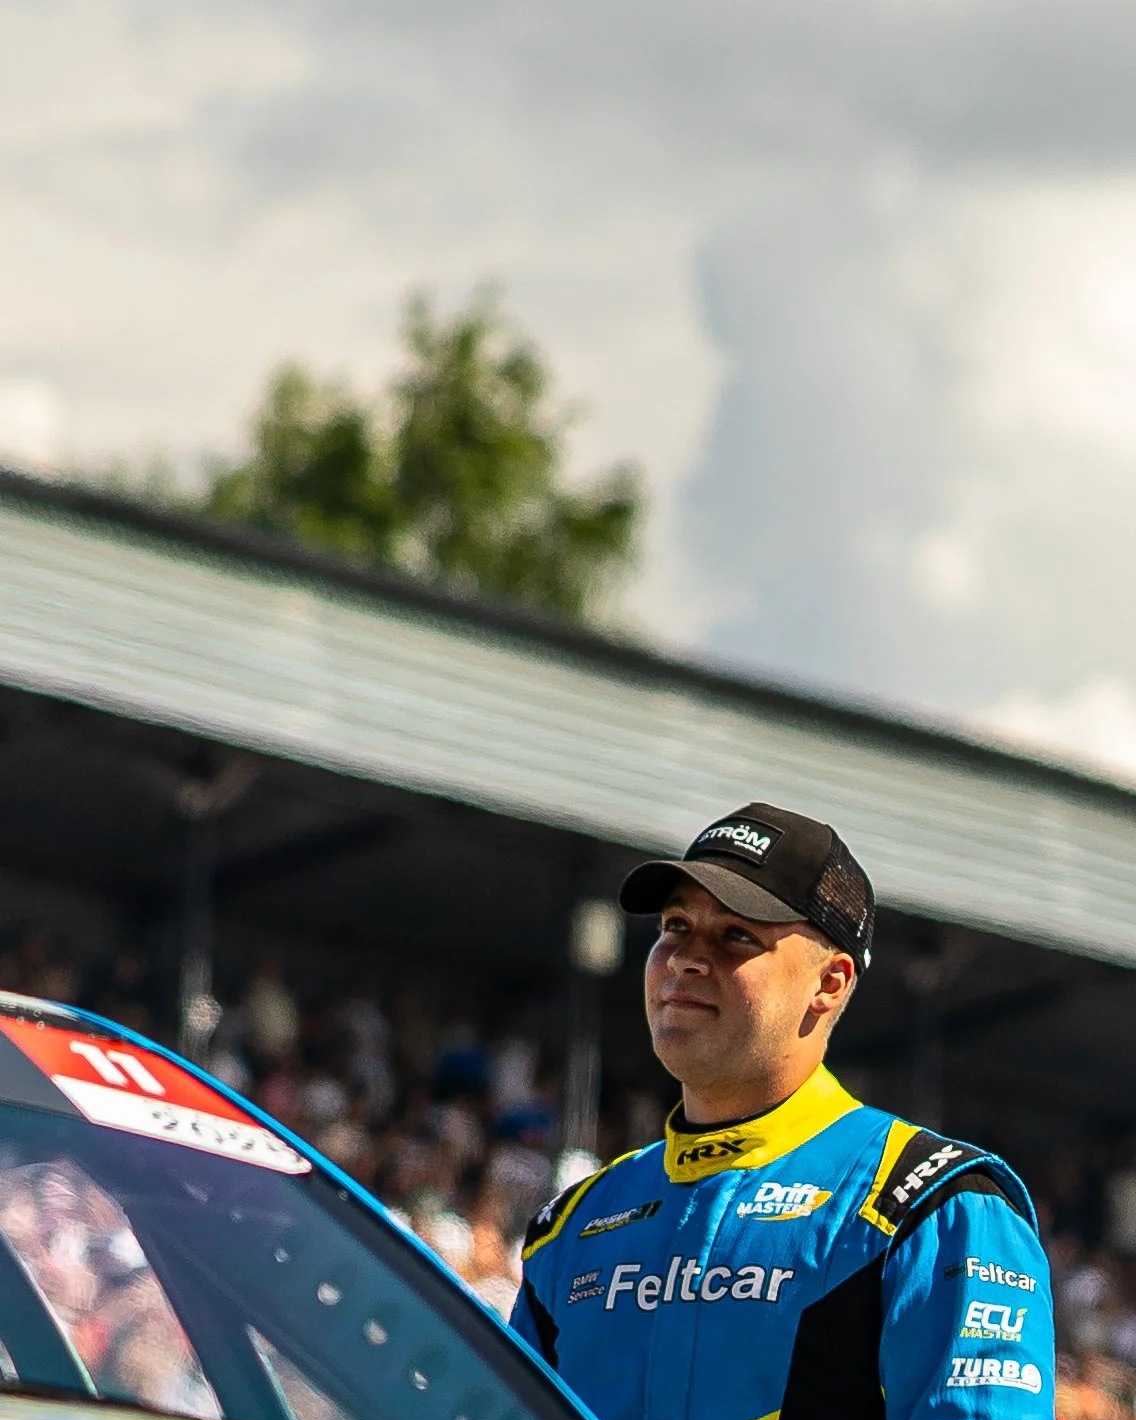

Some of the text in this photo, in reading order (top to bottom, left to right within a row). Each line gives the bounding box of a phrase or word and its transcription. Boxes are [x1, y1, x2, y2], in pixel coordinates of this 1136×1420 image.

[69, 1040, 165, 1096] 11
[676, 1137, 748, 1166] HRX
[892, 1143, 963, 1204] HRX
[754, 1182, 820, 1205] Drift
[737, 1201, 813, 1219] MASTERS
[605, 1256, 795, 1311] Feltcar
[965, 1257, 1036, 1292] Feltcar
[964, 1301, 1026, 1333] ECU
[960, 1327, 1022, 1343] MASTER
